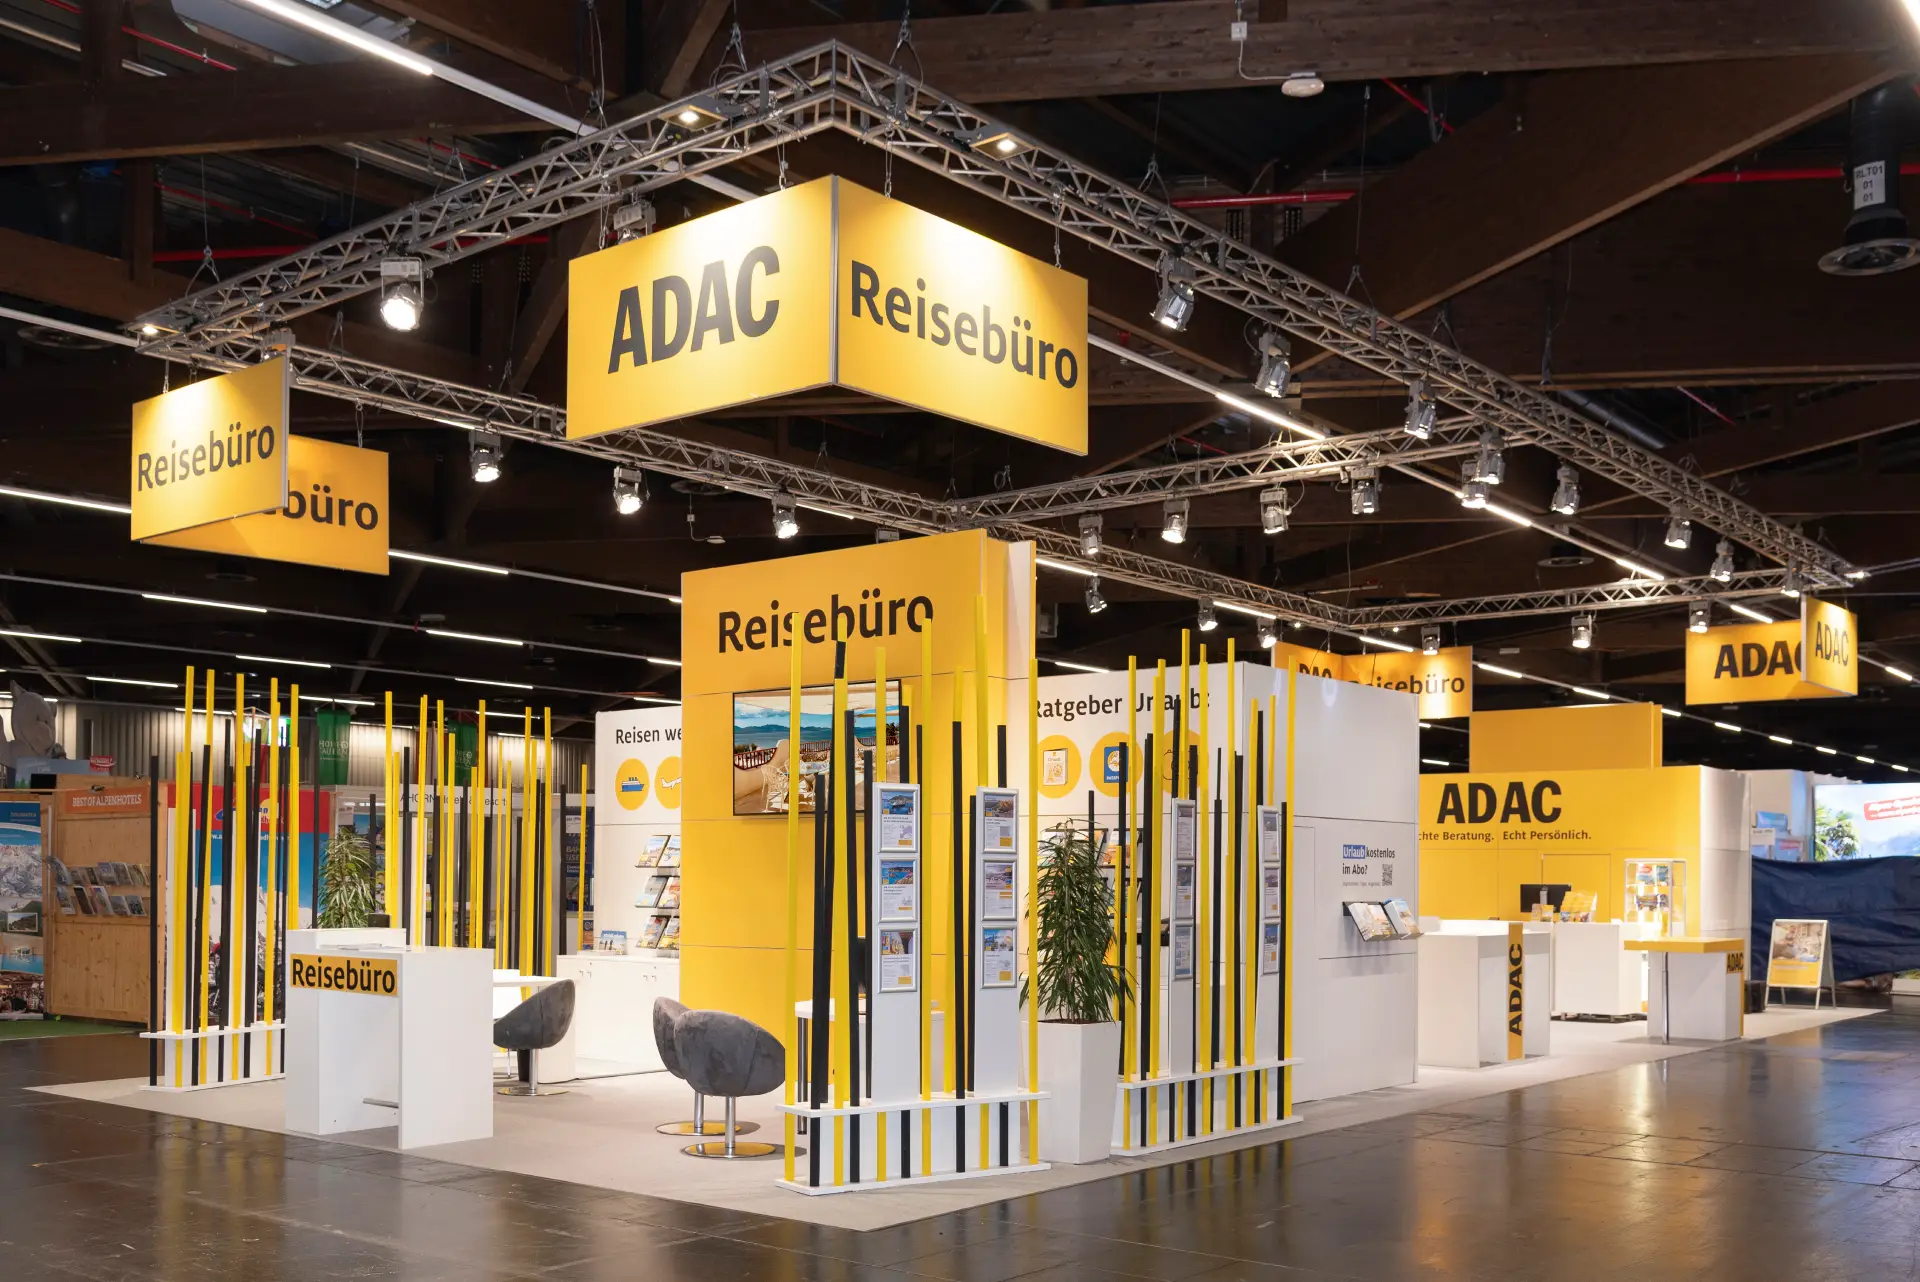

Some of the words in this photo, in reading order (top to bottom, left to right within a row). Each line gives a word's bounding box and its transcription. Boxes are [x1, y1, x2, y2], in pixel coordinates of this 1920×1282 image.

[1863, 180, 1873, 190] 01
[1863, 192, 1873, 202] 01
[607, 245, 780, 374] ADAC
[850, 260, 1078, 388] Reisebüro
[137, 421, 275, 491] Reisebüro
[263, 480, 379, 531] büro
[1714, 640, 1802, 679] ADA
[1815, 621, 1849, 667] ADAC
[1348, 673, 1465, 695] isebüro
[615, 726, 660, 745] Reisen
[72, 797, 87, 807] BEST
[87, 797, 96, 807] OF
[96, 794, 142, 806] ALPENHOTELS
[1437, 779, 1562, 824] ADAC
[1343, 846, 1365, 858] Urlaub
[1366, 847, 1396, 859] kostenlos
[1443, 831, 1495, 843] Beratung.
[1503, 830, 1527, 841] Echt
[1530, 829, 1592, 841] Persönlich.
[1342, 863, 1351, 875] im
[1352, 864, 1368, 875] Abo?
[292, 957, 395, 993] Reisebüro
[1509, 944, 1523, 1037] ADAC
